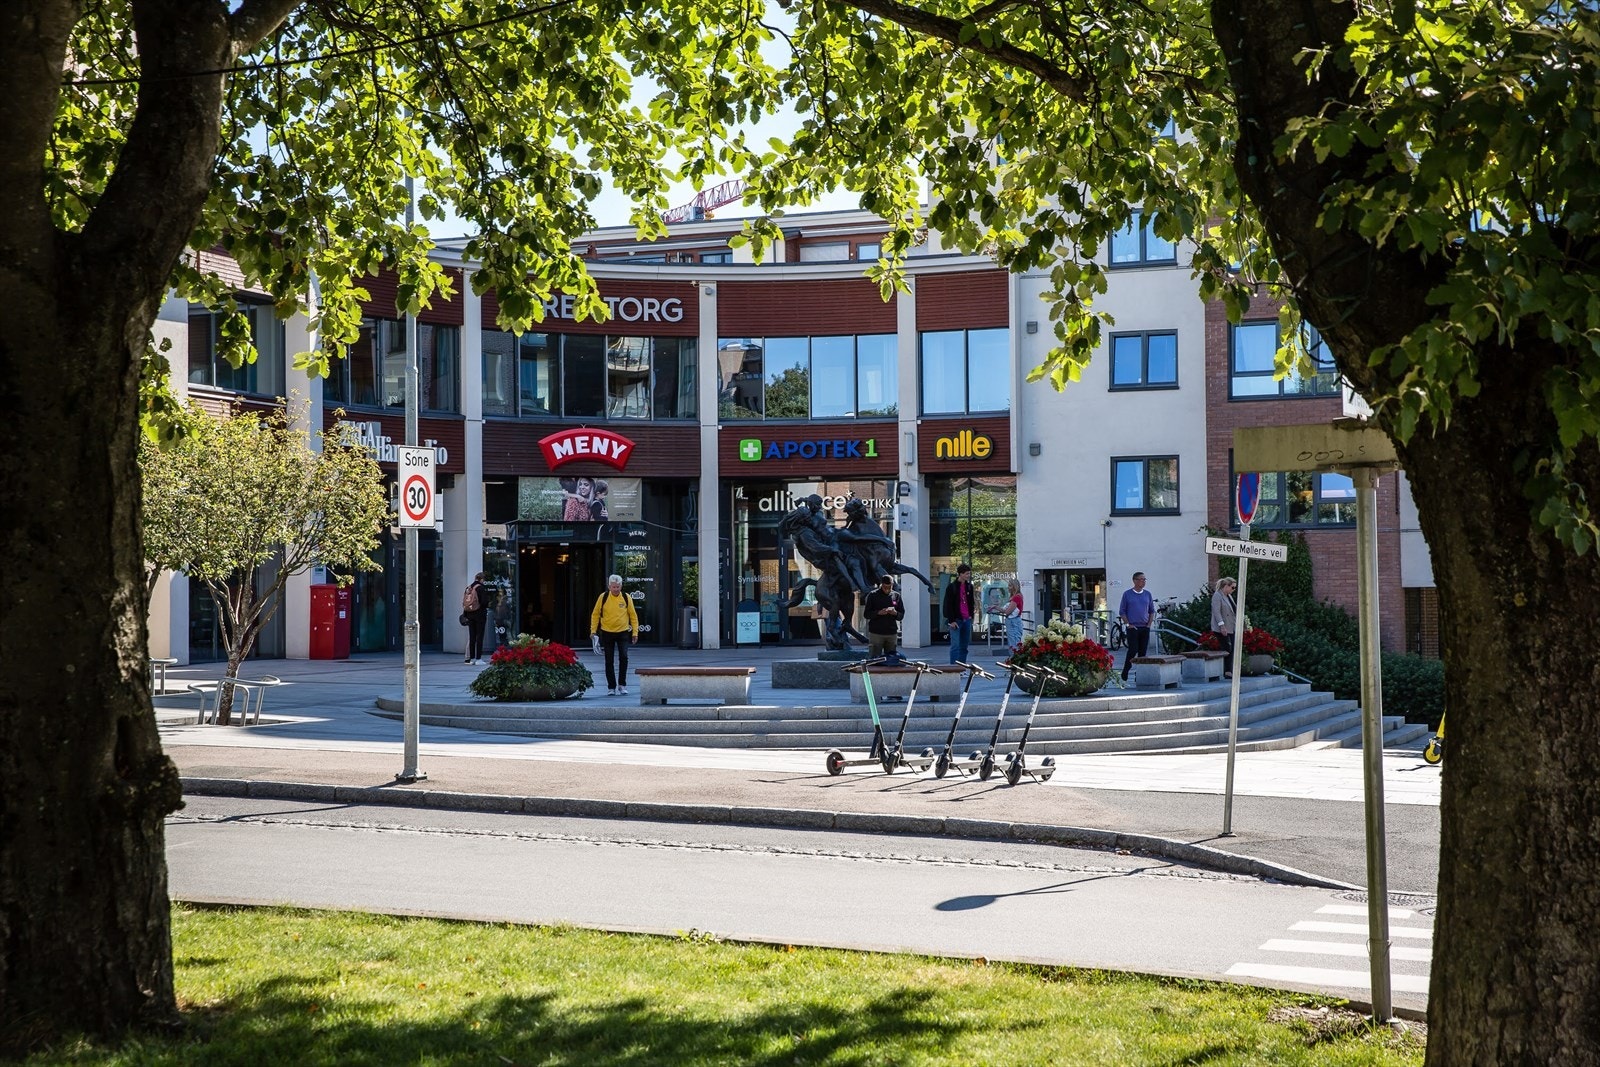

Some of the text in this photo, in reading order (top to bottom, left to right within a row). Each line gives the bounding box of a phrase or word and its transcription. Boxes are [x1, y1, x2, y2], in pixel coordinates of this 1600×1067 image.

[603, 296, 684, 323] TORG
[551, 435, 628, 460] MENY
[765, 438, 878, 459] APOTEK 1
[936, 429, 991, 459] nille
[405, 452, 429, 467] Sone
[408, 487, 426, 509] 30
[1211, 541, 1282, 558] Peter Møllers vei
